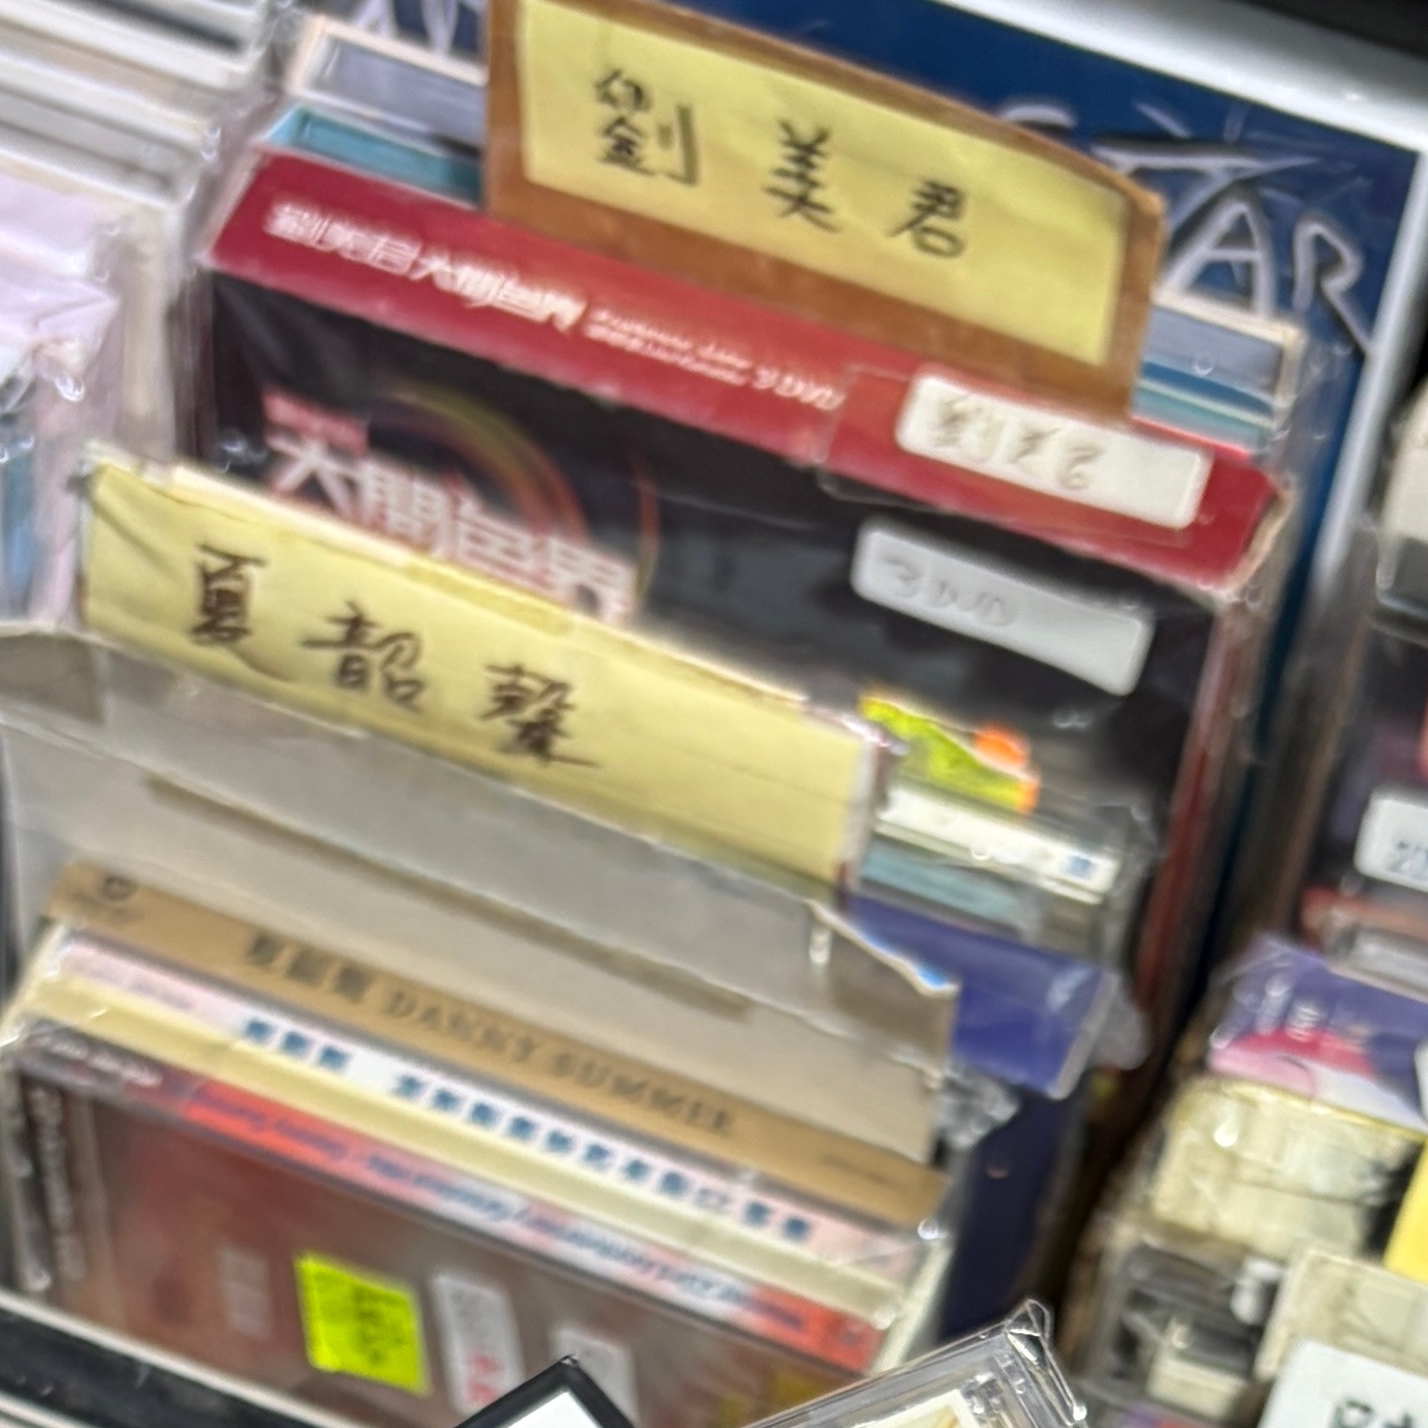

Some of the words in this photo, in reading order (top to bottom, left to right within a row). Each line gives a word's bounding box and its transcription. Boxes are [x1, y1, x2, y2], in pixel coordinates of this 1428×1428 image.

[592, 66, 966, 262] 劉美君
[191, 542, 600, 772] 夏韶聲
